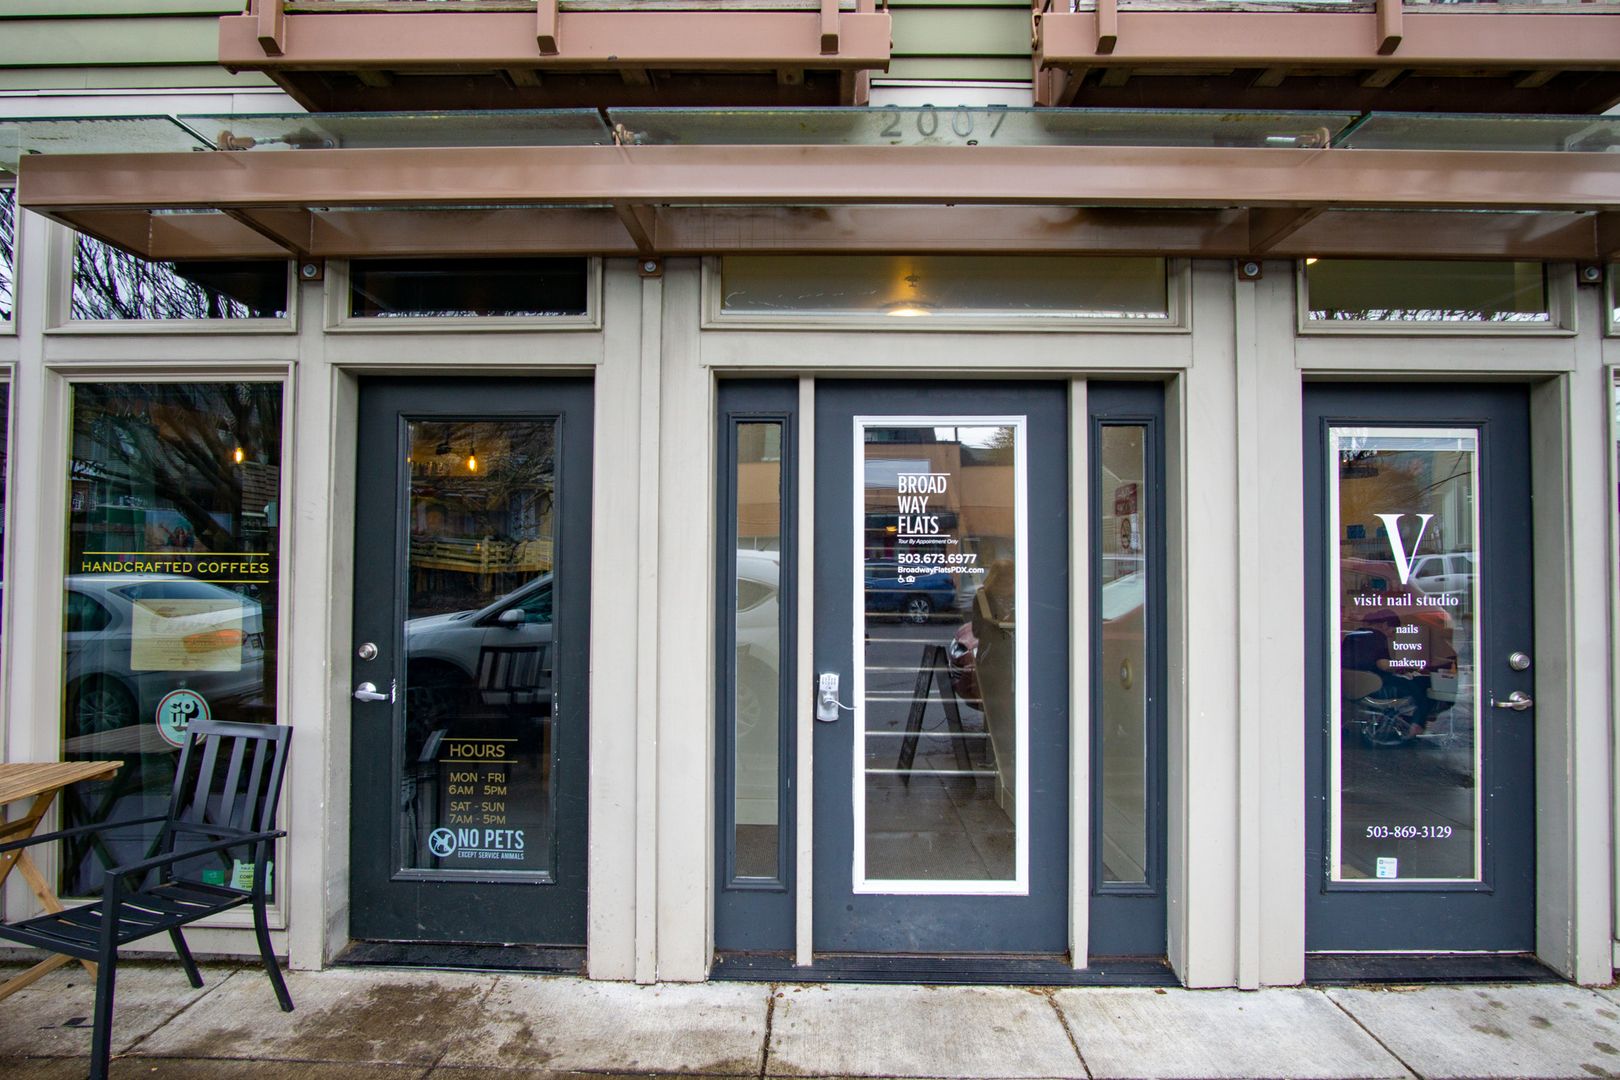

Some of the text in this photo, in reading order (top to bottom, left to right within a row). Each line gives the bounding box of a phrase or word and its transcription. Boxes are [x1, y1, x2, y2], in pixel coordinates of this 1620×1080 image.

[880, 104, 1008, 138] 2007
[898, 476, 947, 494] BROAD
[897, 496, 929, 514] WAY
[898, 516, 939, 534] FLATS
[1373, 513, 1434, 585] V
[898, 553, 977, 564] 503.673.6977
[81, 561, 270, 574] HANDCRAFTED COFFEES
[897, 566, 984, 575] BroadwayFlatsPDX.com
[1353, 593, 1459, 606] visit nail studio
[1395, 624, 1419, 634] nails
[1393, 641, 1422, 651] brows
[1389, 658, 1427, 670] makeup
[450, 744, 506, 757] HOURS
[449, 772, 478, 783] MON
[487, 772, 506, 783] FRI
[448, 784, 507, 796] 6AM 5PM
[450, 801, 472, 812] SAT
[481, 802, 505, 812] SUN
[449, 813, 473, 824] 7AM
[482, 814, 506, 825] 5PM
[1366, 826, 1452, 838] 503-869-3129
[458, 828, 524, 849] NO PETS
[478, 851, 500, 859] SERVICE
[500, 852, 524, 860] ANIMALS
